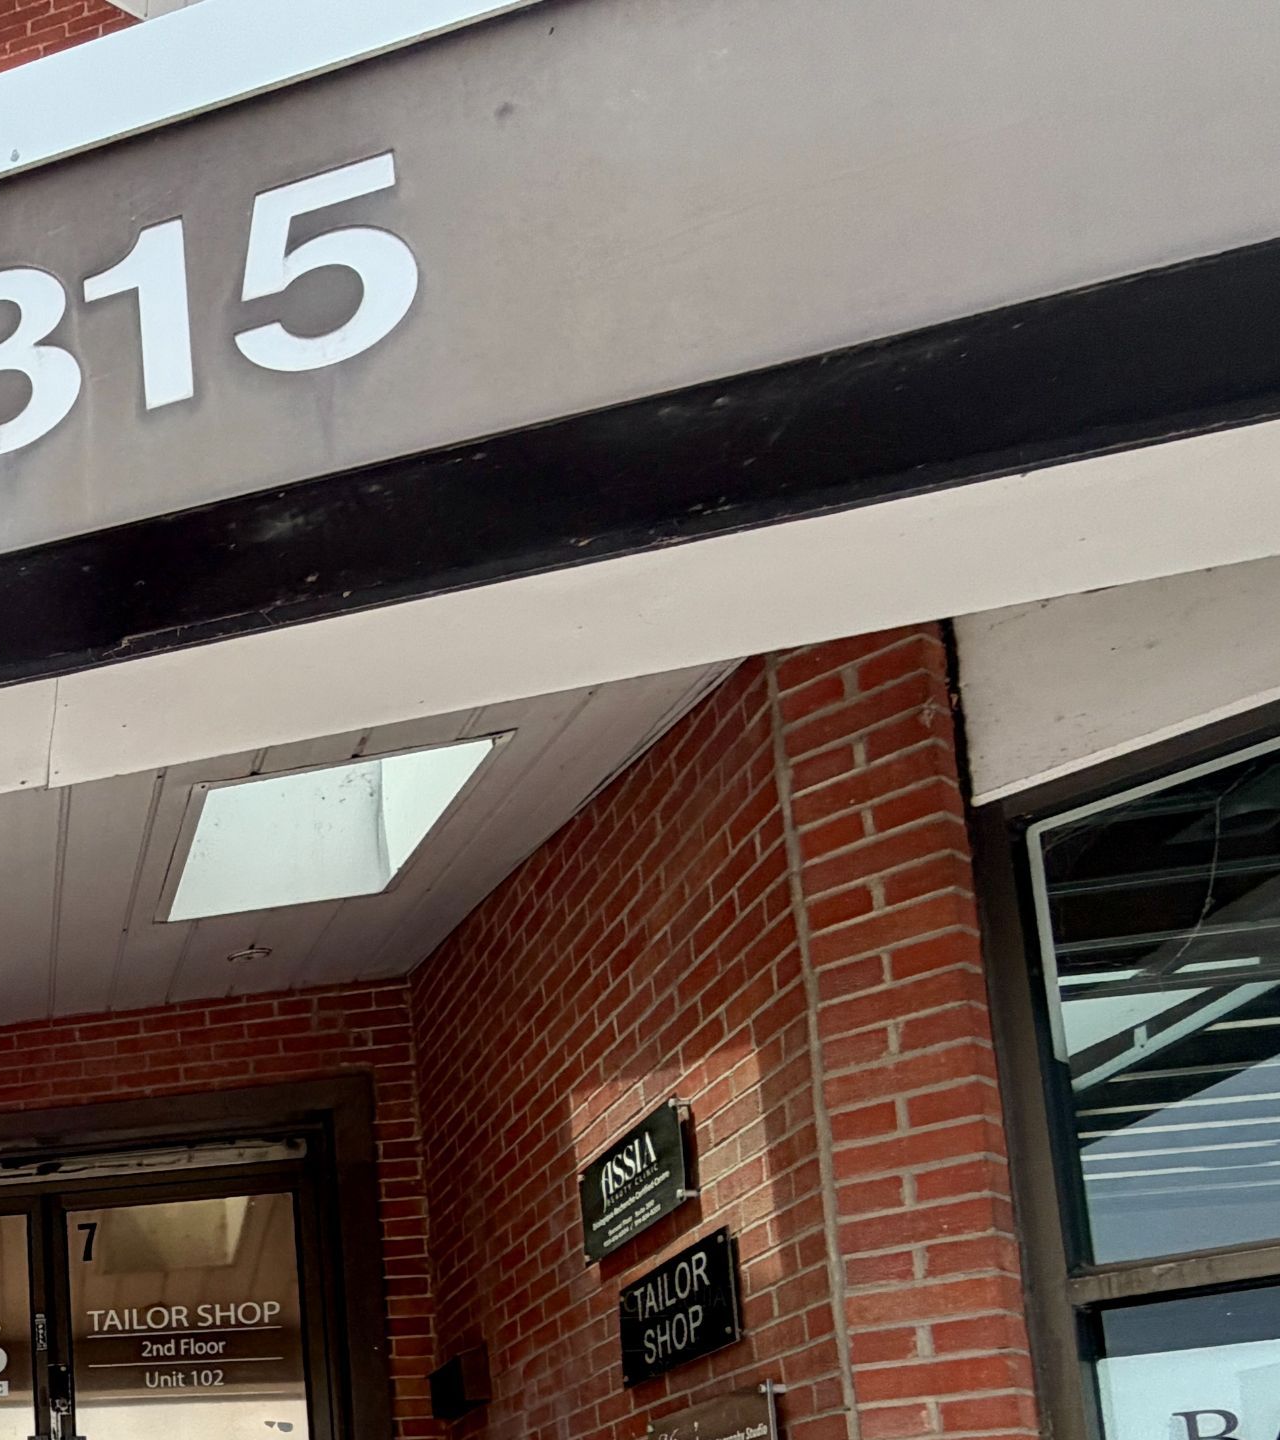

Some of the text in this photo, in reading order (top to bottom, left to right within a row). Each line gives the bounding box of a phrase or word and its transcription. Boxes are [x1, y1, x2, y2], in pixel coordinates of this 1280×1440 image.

[600, 1131, 657, 1213] ASSIA
[77, 1221, 99, 1263] 7
[633, 1251, 711, 1322] TAILOR
[86, 1300, 281, 1332] TAILOR SHOP
[643, 1304, 703, 1364] SHOP
[141, 1338, 227, 1358] 2nd Floor
[144, 1369, 225, 1389] Unit 102
